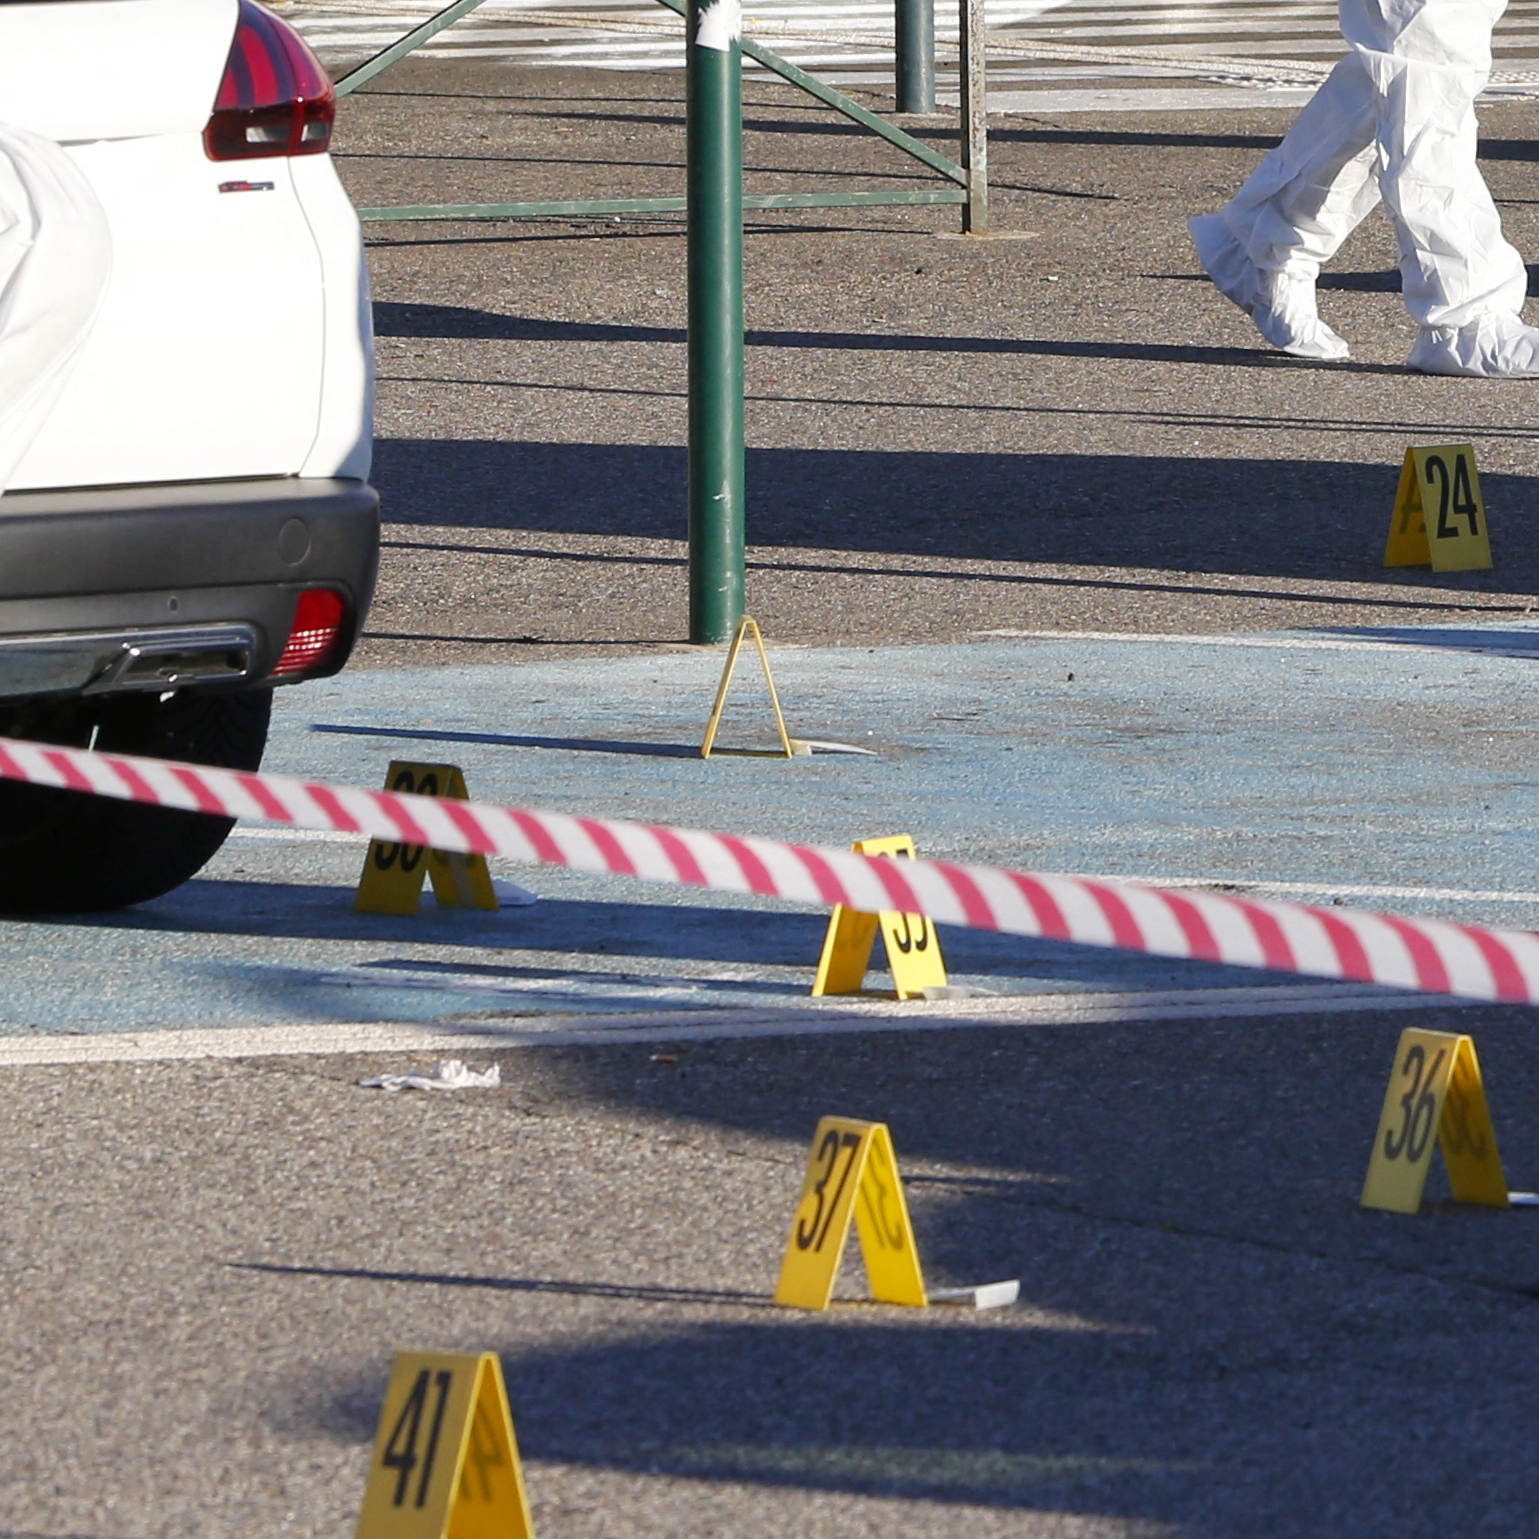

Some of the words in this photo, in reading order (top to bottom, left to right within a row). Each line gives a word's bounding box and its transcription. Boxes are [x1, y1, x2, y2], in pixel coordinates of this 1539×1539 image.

[1425, 453, 1478, 540] 24
[1384, 1044, 1446, 1164] 36
[797, 1130, 861, 1253] 37
[383, 1369, 452, 1508] 41
